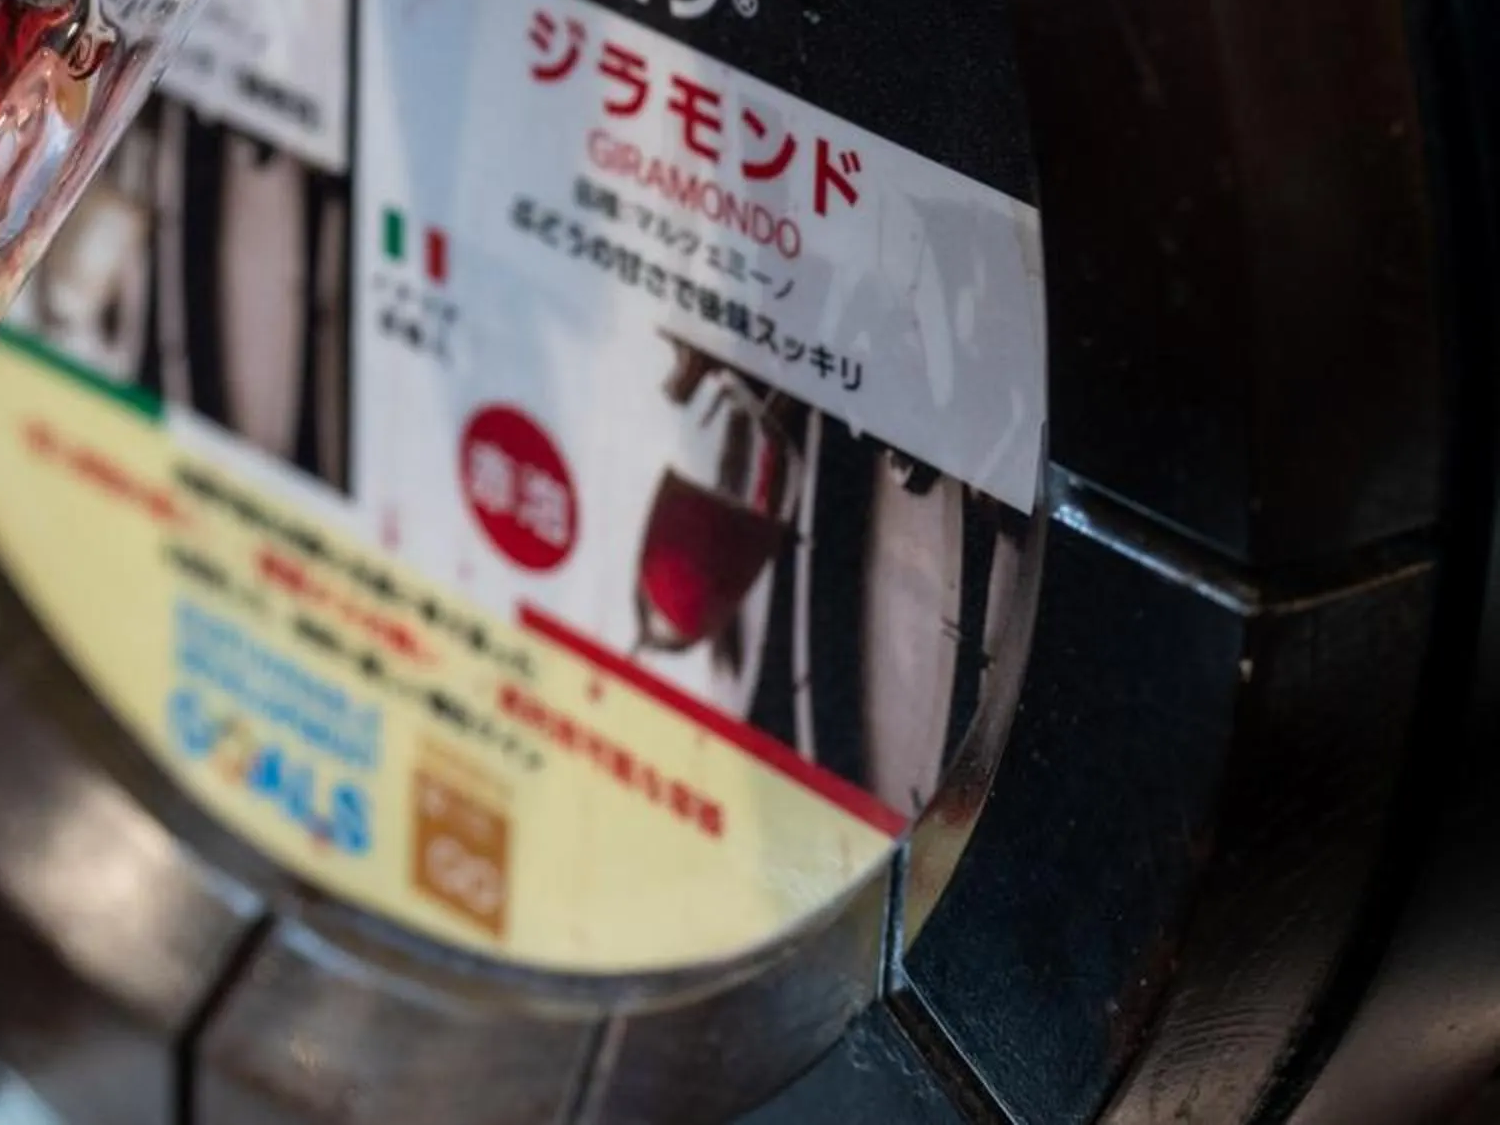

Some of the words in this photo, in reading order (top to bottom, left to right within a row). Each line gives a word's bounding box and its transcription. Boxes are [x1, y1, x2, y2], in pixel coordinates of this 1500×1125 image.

[526, 7, 864, 218] ジラモンド
[585, 127, 804, 261] GIRAMONDO
